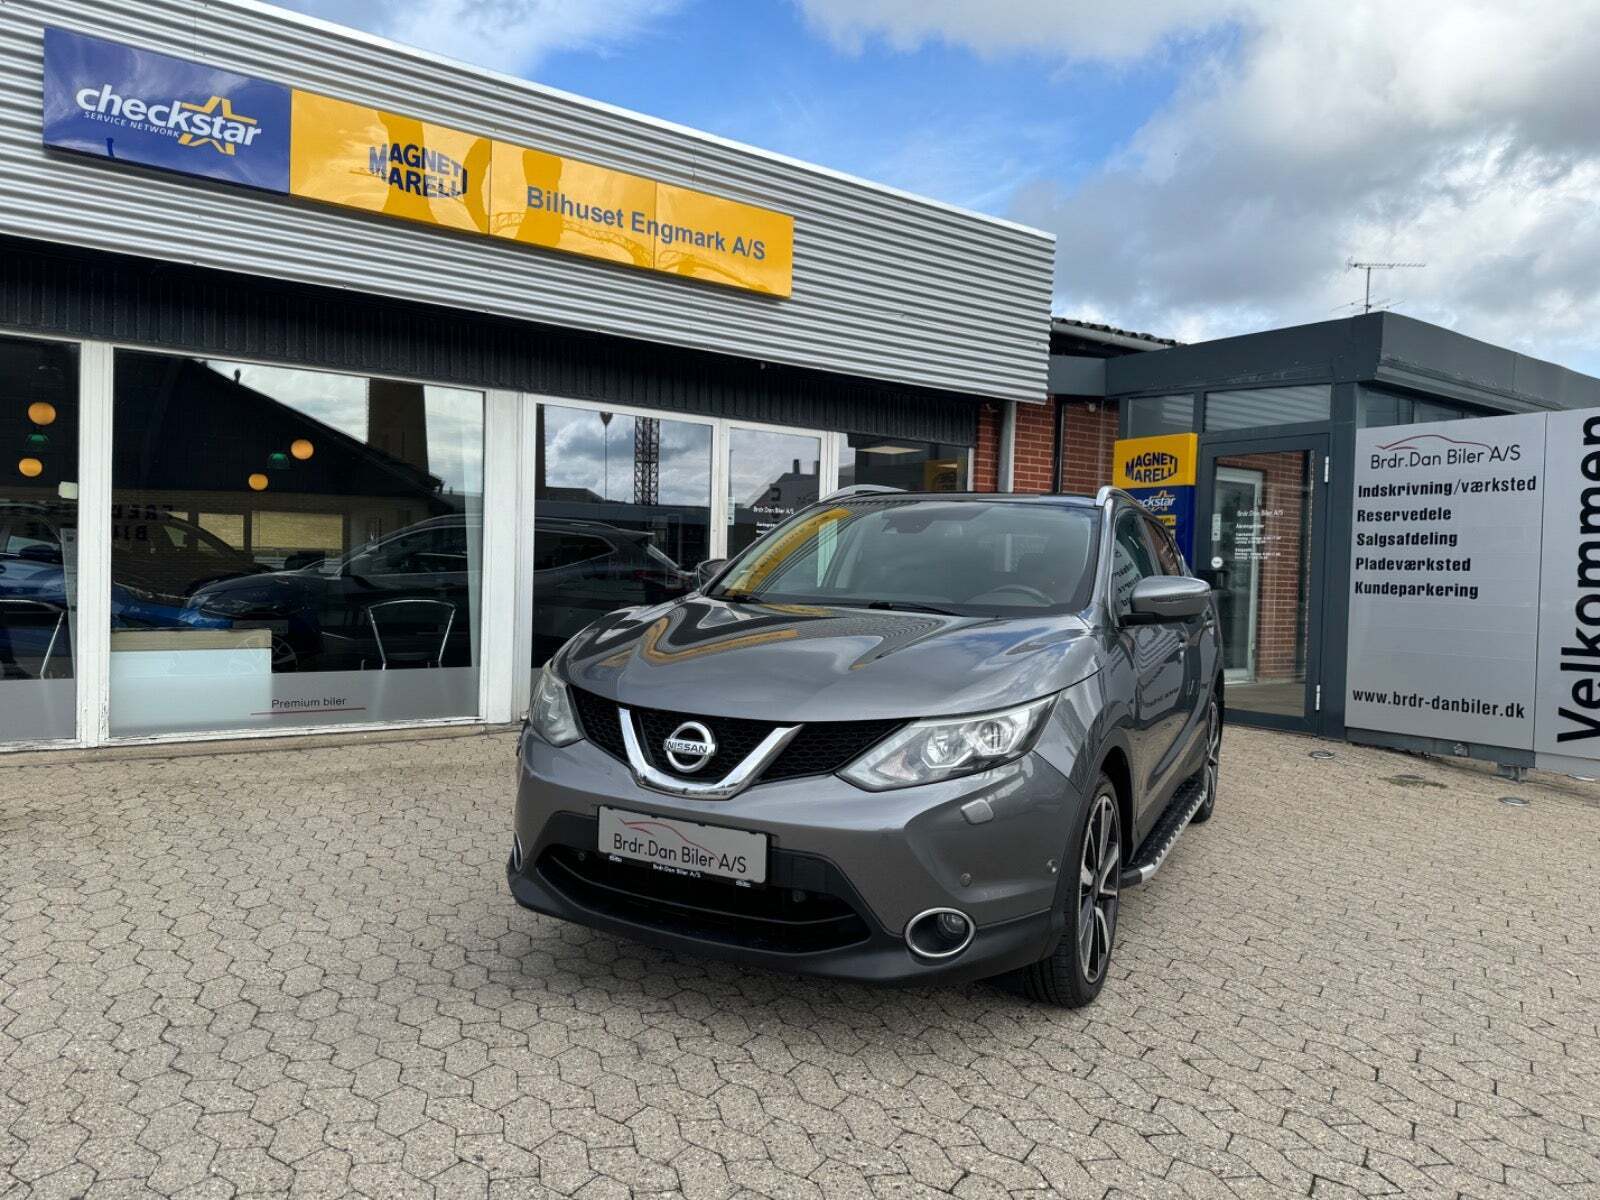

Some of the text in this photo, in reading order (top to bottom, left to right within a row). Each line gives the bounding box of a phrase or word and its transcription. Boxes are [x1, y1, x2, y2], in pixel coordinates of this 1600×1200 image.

[76, 84, 262, 146] checkstar
[84, 110, 180, 139] SERVICE NETWORK
[369, 143, 467, 183] MAGNETI
[526, 185, 766, 261] Bilhuset Engmark A/S
[1125, 452, 1178, 474] MAGNETI
[1370, 444, 1521, 470] Brdr.Dan Biler A/S
[1358, 475, 1537, 498] Indskrivning/værksted
[1357, 507, 1452, 522] Reservedele
[1356, 531, 1458, 548] Salgsafdeling
[1355, 557, 1471, 572] Pladeværksted
[1355, 581, 1479, 600] Kundeparkering
[271, 696, 347, 709] Premium biler
[1352, 689, 1525, 719] www.brdr-danbiler.dk
[667, 741, 708, 753] NISSAN
[613, 832, 747, 874] Brdr.Dan Biler A/S
